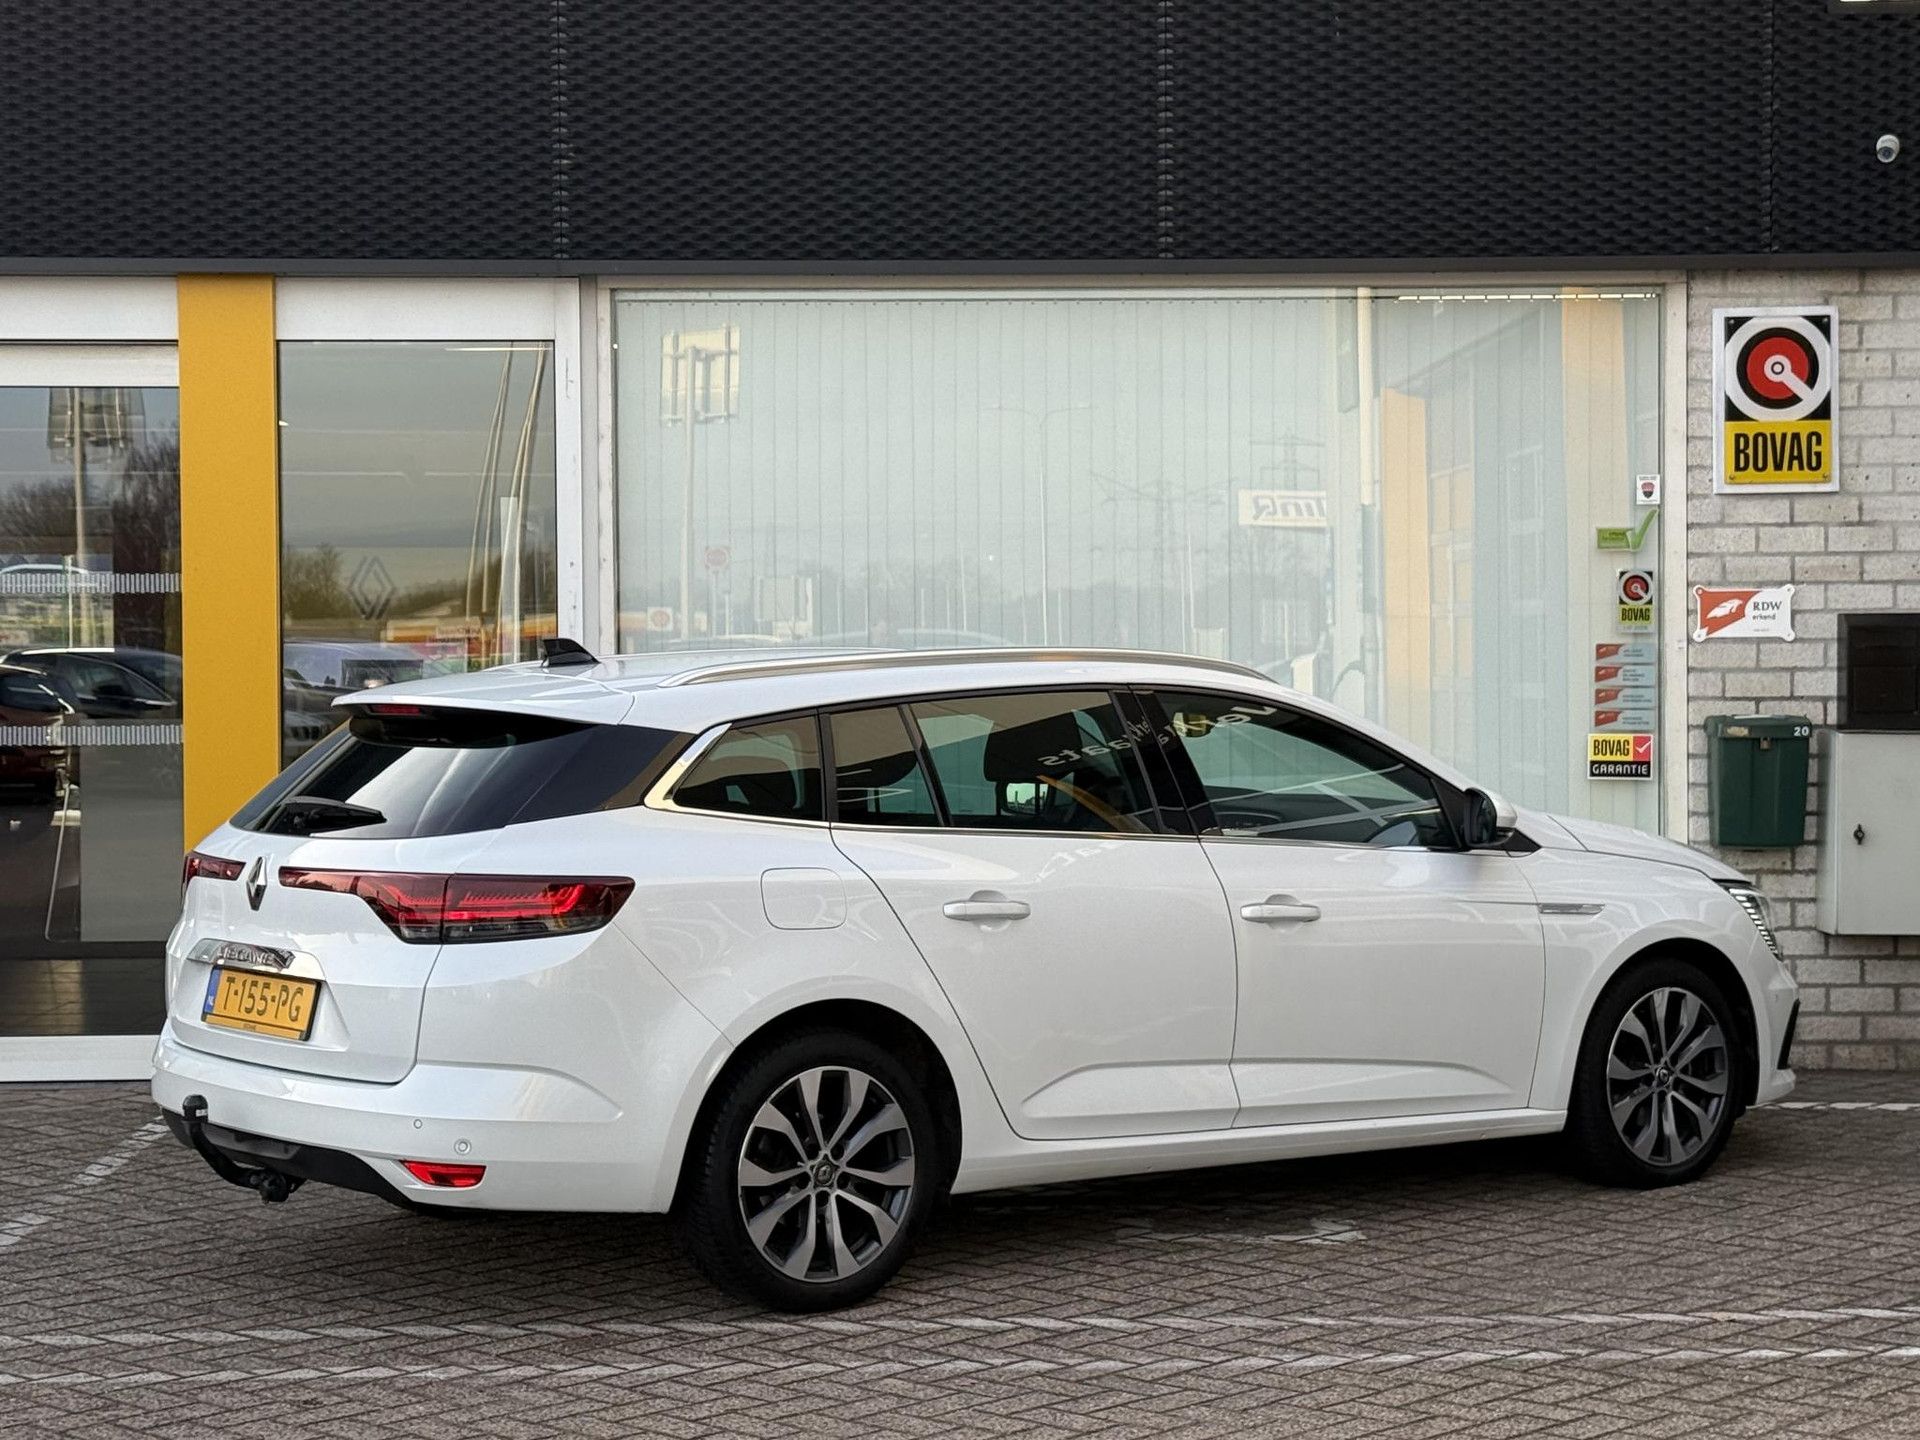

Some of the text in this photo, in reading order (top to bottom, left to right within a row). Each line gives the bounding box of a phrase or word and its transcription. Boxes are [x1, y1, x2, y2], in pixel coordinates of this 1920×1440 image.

[1733, 431, 1822, 473] BOVAG
[1752, 601, 1783, 611] RDW
[1621, 608, 1650, 622] BOVAG
[1752, 612, 1777, 621] erkend
[1793, 726, 1809, 737] 20
[1592, 738, 1631, 757] BOVAG
[1591, 763, 1649, 775] GARANTIE
[223, 976, 304, 1022] T-155-PG
